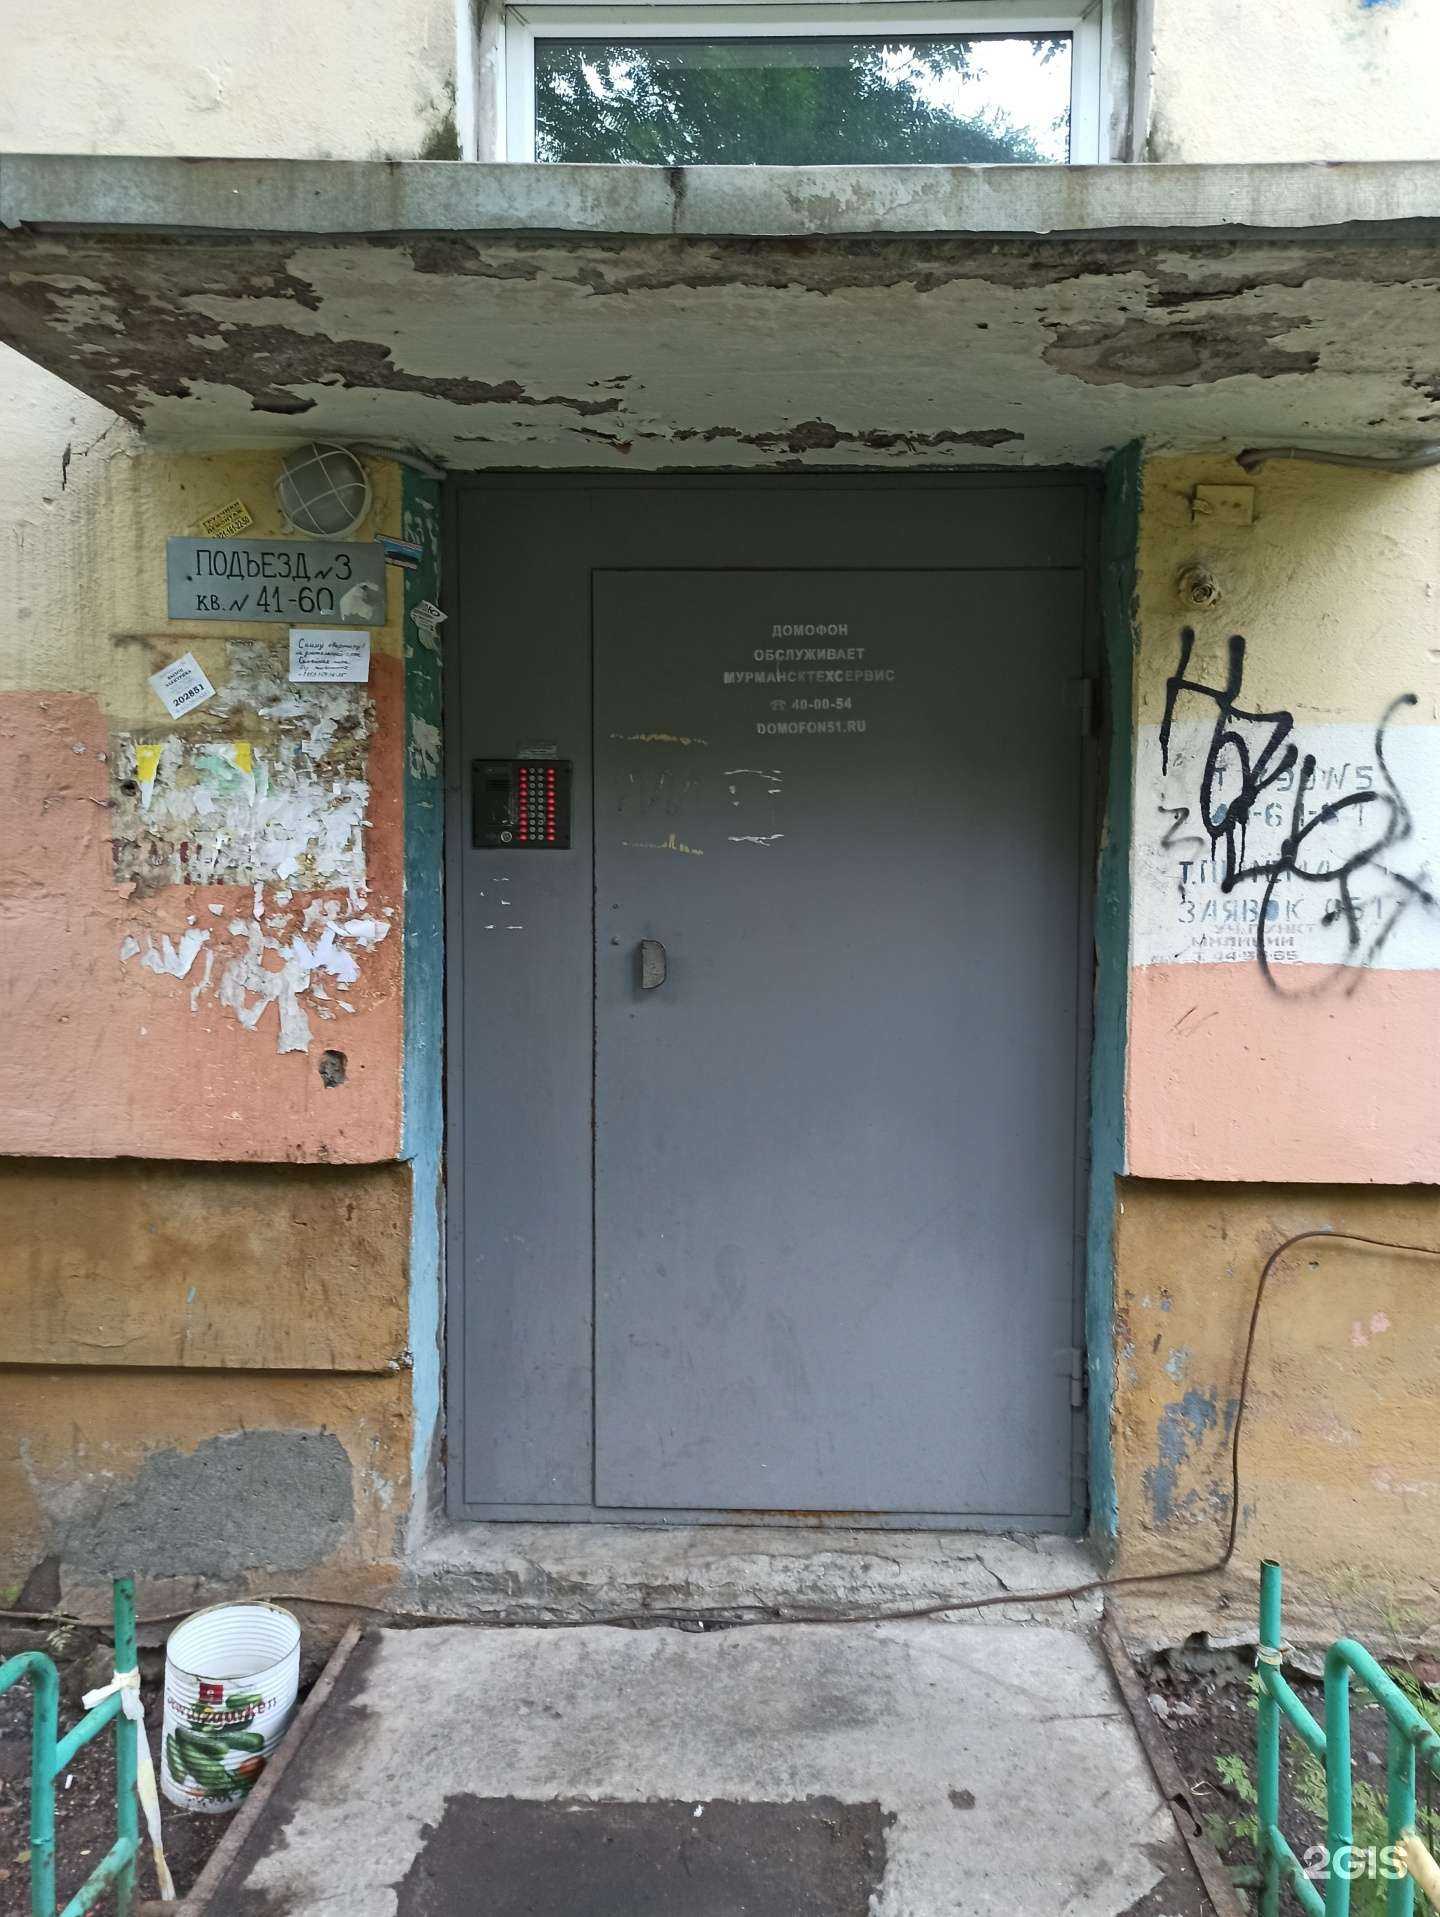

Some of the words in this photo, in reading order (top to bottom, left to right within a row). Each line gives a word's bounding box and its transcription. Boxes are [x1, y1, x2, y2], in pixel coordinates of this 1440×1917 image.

[196, 549, 311, 582] ПОДЪЕЗД
[256, 585, 334, 613] 41-60
[772, 624, 848, 639] ДОМОФОН
[753, 648, 865, 662] ОБСЛУЖИВАЕТ
[723, 669, 896, 684] МУРМАНСКТЕХСЕРВИС
[172, 684, 205, 707] 202851
[756, 720, 867, 734] DOMOFON51.RU
